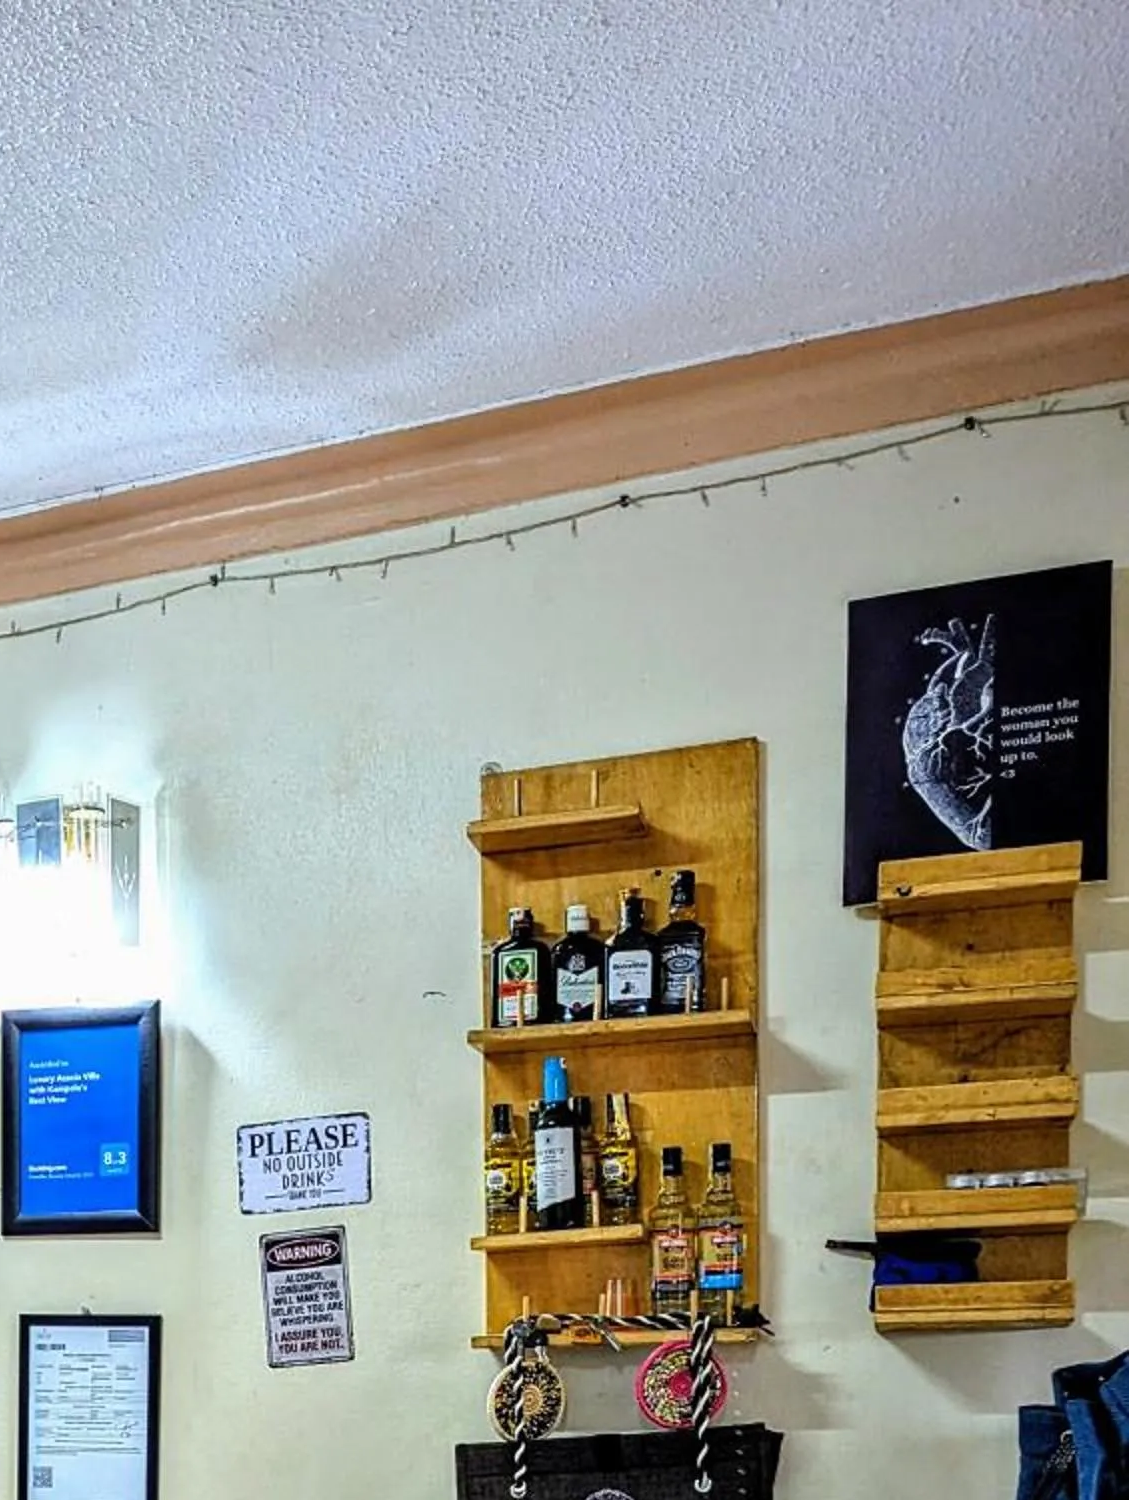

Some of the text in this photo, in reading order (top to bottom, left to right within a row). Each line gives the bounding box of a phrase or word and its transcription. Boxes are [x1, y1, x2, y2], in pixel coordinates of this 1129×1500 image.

[1000, 697, 1080, 718] Become the
[1000, 715, 1079, 732] woman you
[1000, 728, 1074, 747] would look
[1000, 751, 1038, 765] up to.
[247, 1122, 359, 1158] PLEASE
[262, 1150, 343, 1174] NO OUTSIDE
[282, 1168, 336, 1190] DRINKS
[274, 1243, 332, 1261] WARNING
[285, 1271, 325, 1283] ALCOHOL
[273, 1290, 340, 1306] WILL MAKE YOU
[307, 1303, 325, 1313] YOU
[327, 1300, 344, 1311] ARE
[280, 1328, 318, 1343] ASSURE
[278, 1343, 298, 1354] YOU
[300, 1340, 320, 1352] ARE
